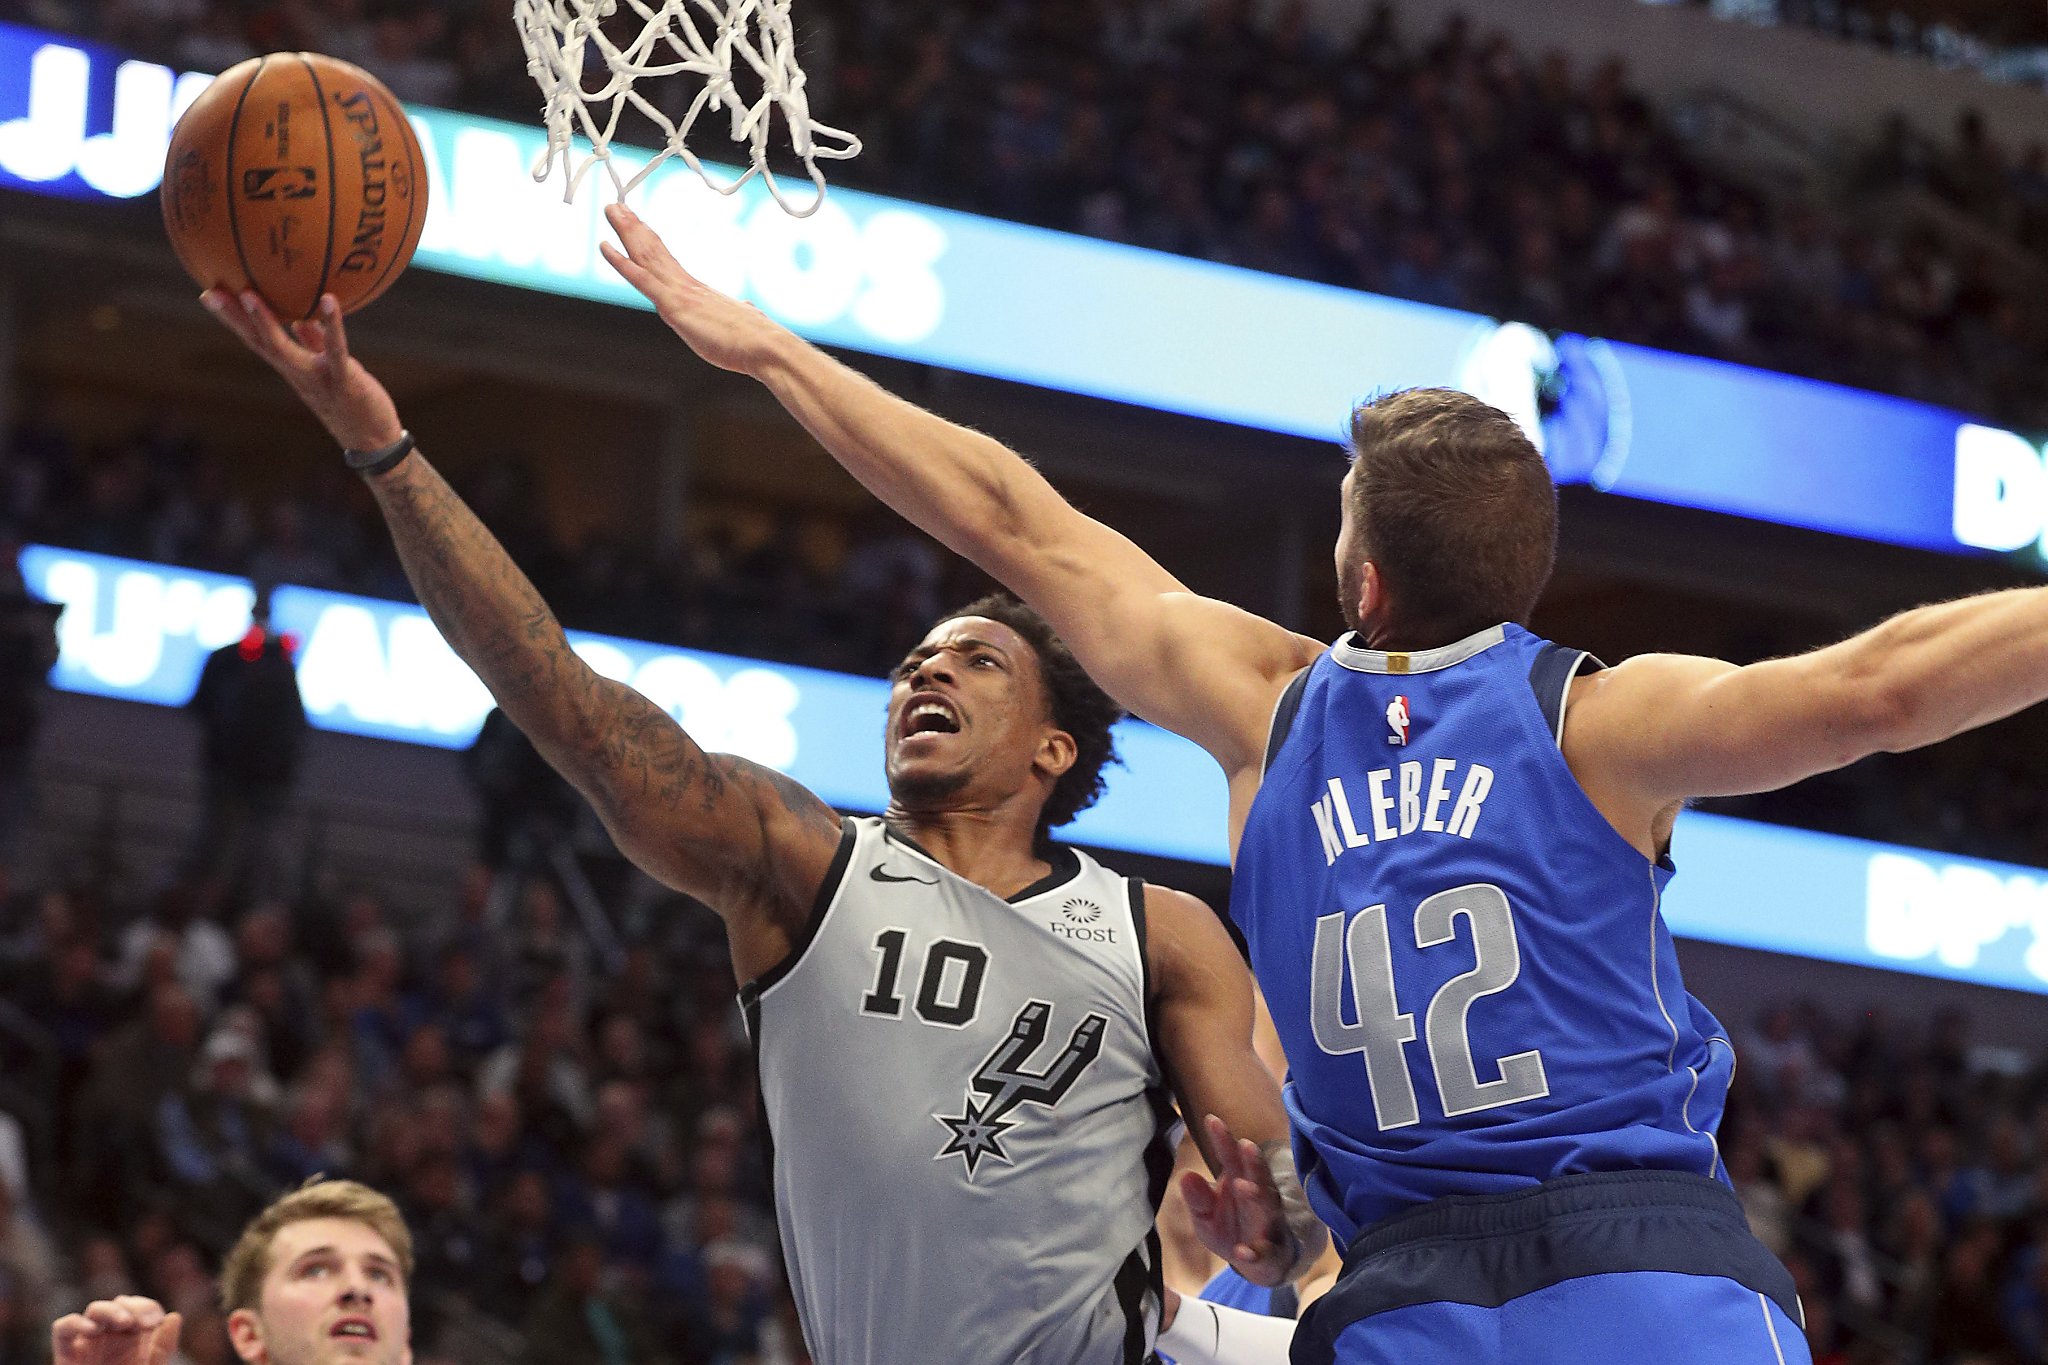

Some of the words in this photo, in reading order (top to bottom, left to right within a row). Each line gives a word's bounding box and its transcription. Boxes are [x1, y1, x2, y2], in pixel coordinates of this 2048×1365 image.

[334, 91, 384, 276] SPALDING
[1310, 758, 1494, 866] KLEBER
[859, 926, 992, 1029] 10
[1049, 922, 1117, 944] Frost
[1310, 882, 1550, 1132] 42
